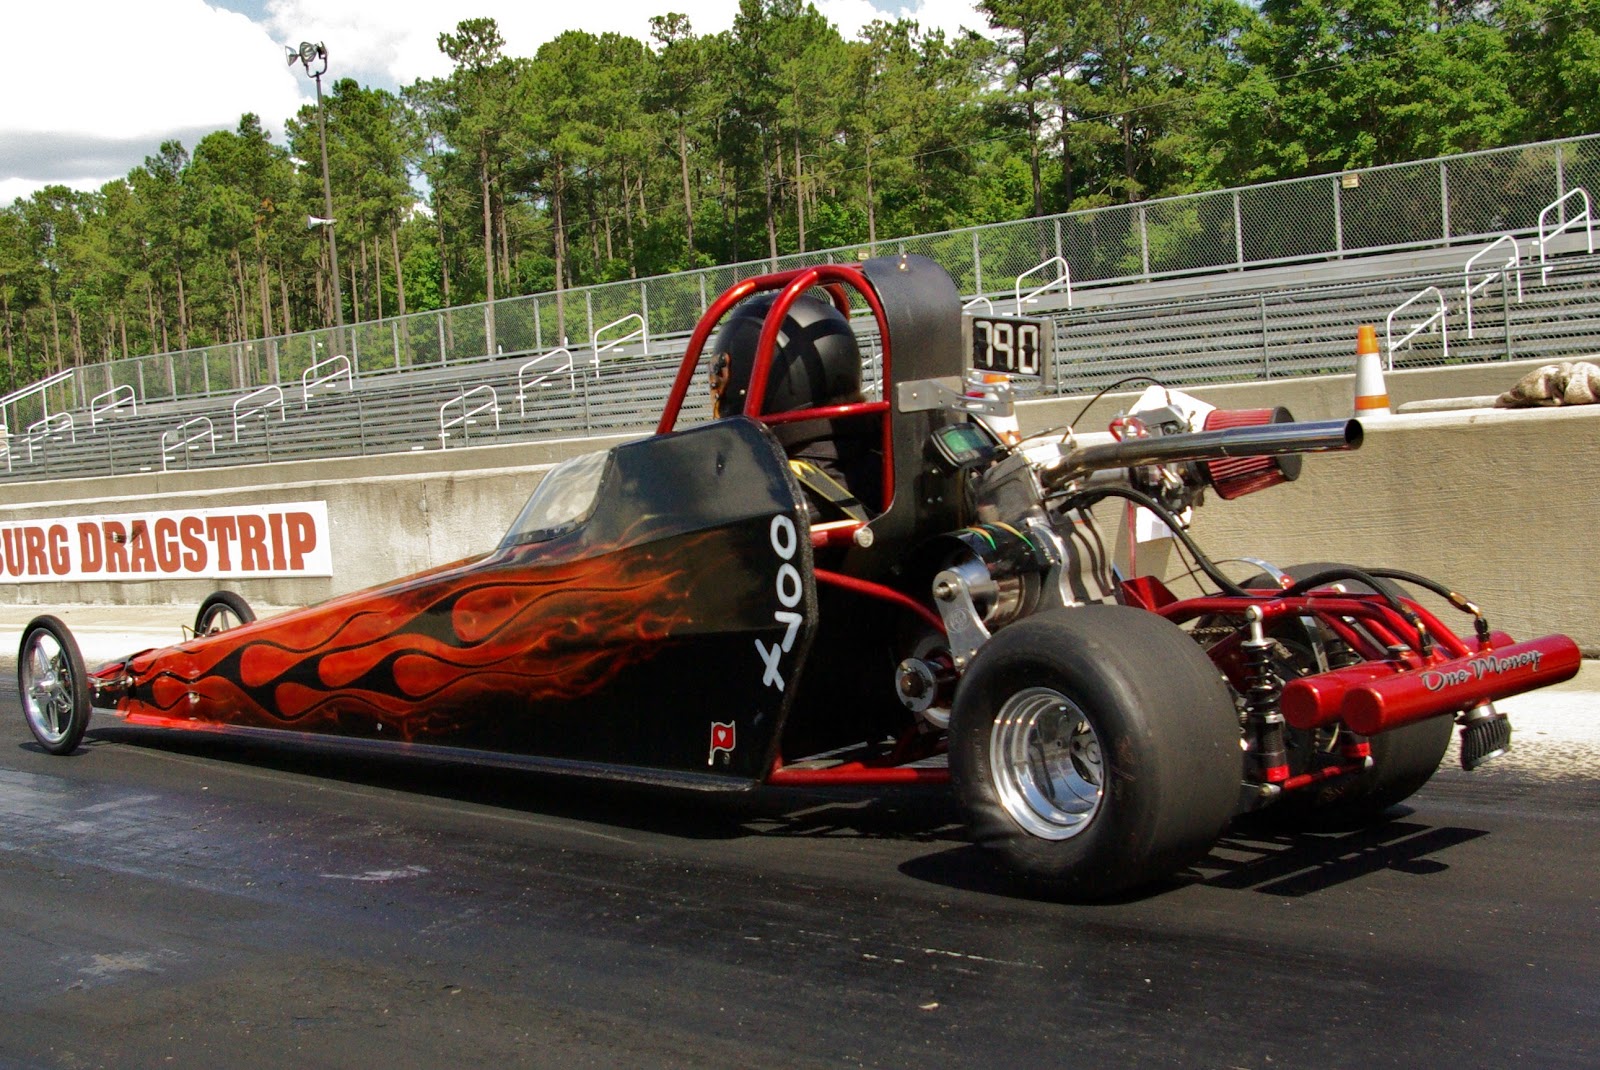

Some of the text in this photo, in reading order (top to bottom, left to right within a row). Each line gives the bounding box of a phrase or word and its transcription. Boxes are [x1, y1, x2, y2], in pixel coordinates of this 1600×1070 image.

[975, 321, 1038, 374] 790
[0, 512, 317, 577] URG DRAGSTRIP
[1420, 650, 1544, 692] One Money
